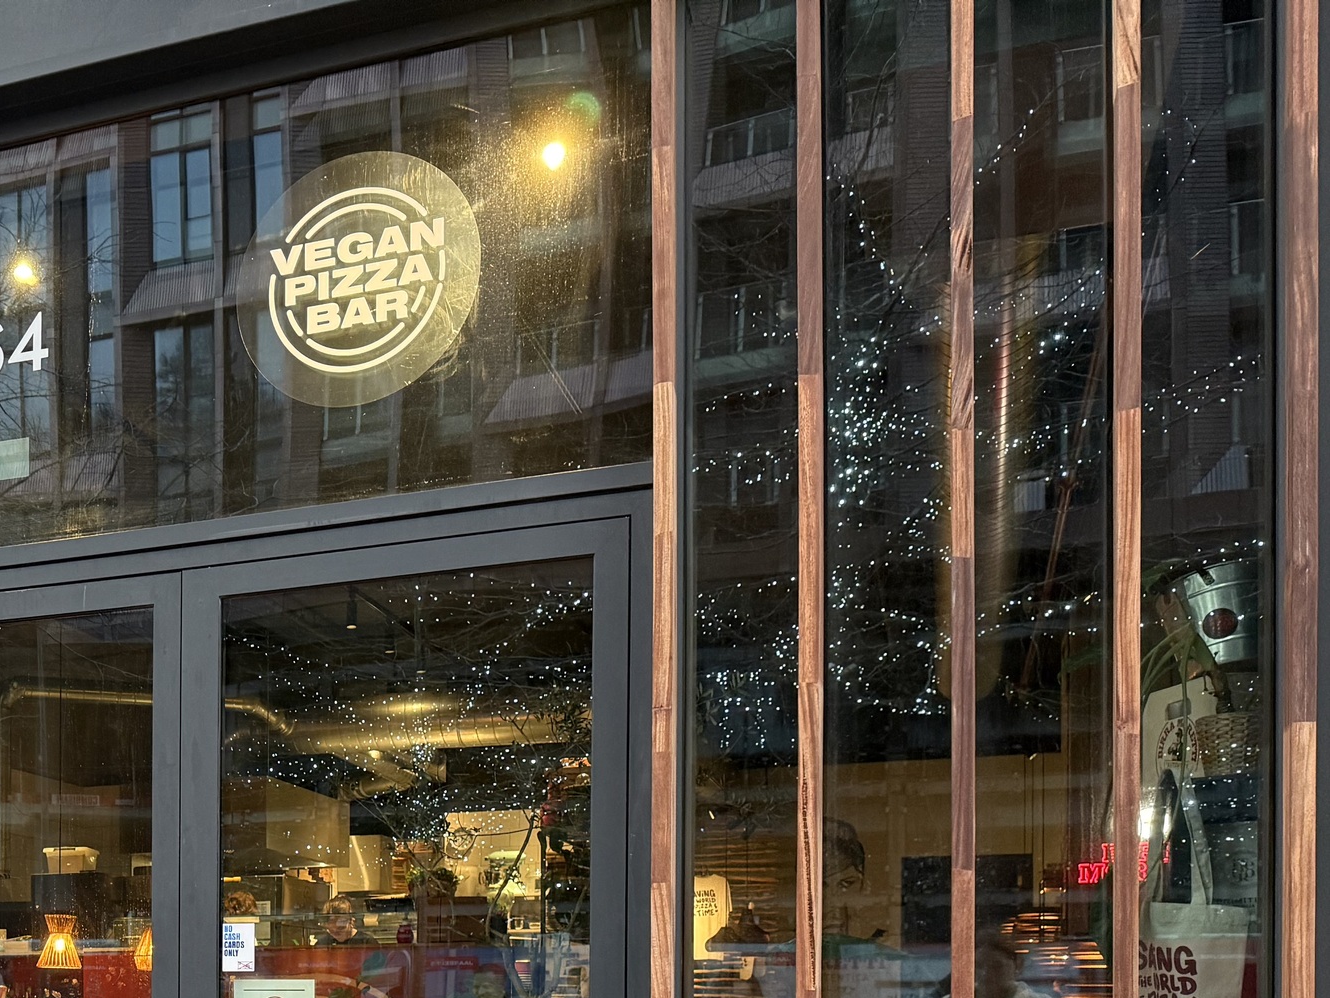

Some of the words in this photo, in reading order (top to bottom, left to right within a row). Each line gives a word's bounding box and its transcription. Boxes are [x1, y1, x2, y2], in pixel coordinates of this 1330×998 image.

[270, 217, 445, 276] VEGAN
[284, 254, 433, 307] PIZZA
[306, 291, 408, 335] BAR
[224, 941, 245, 949] CARDS
[224, 949, 239, 957] ONLY
